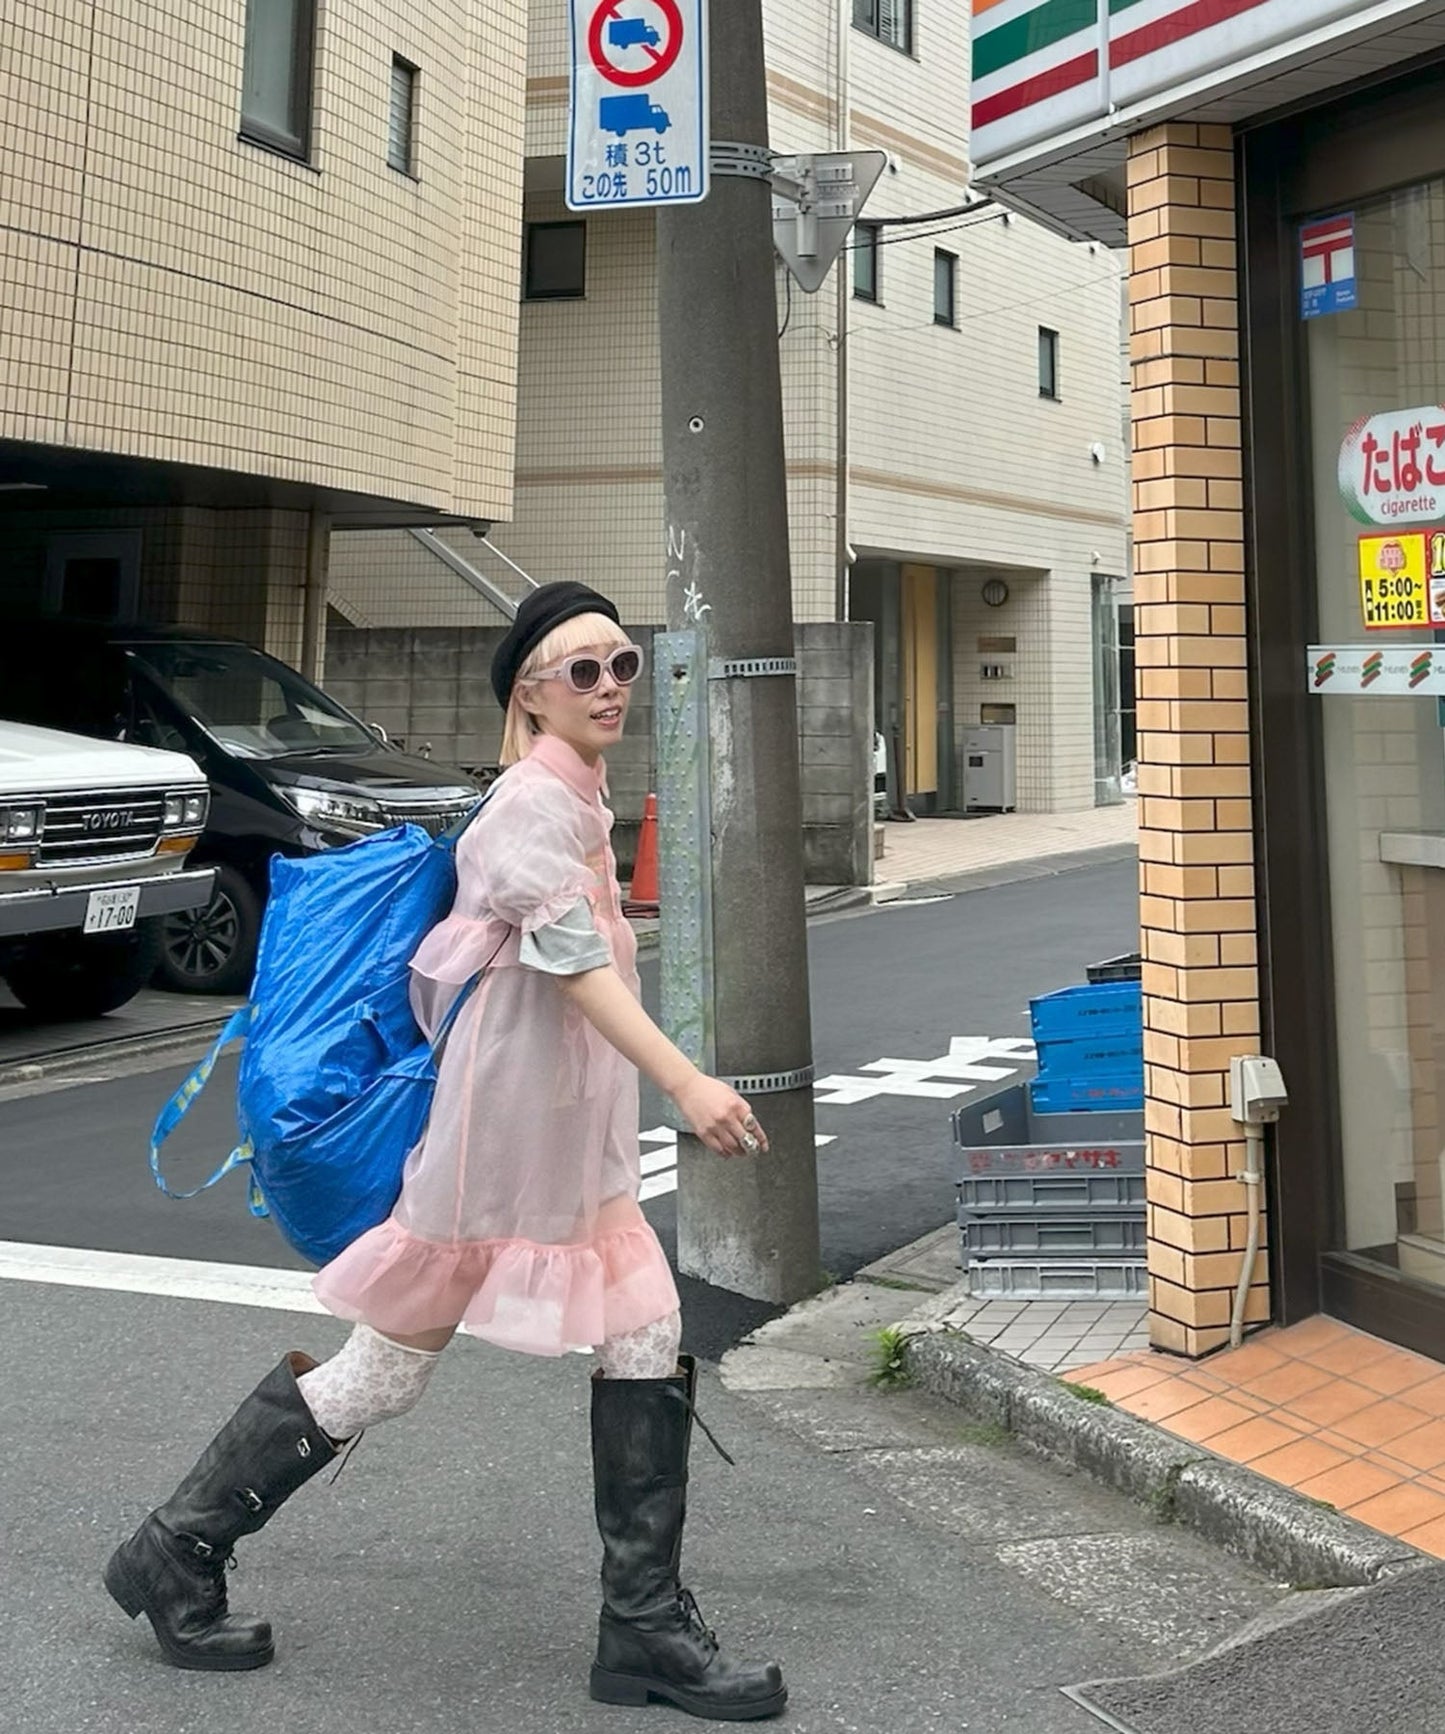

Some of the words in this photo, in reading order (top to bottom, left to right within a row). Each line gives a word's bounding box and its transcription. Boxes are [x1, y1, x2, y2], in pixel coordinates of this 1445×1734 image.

[582, 171, 628, 199] この先
[646, 165, 691, 195] 50m
[1361, 421, 1445, 495] たばこ
[1381, 496, 1436, 517] cigarette
[1375, 600, 1414, 621] 11:00
[82, 811, 134, 831] TOYOTA
